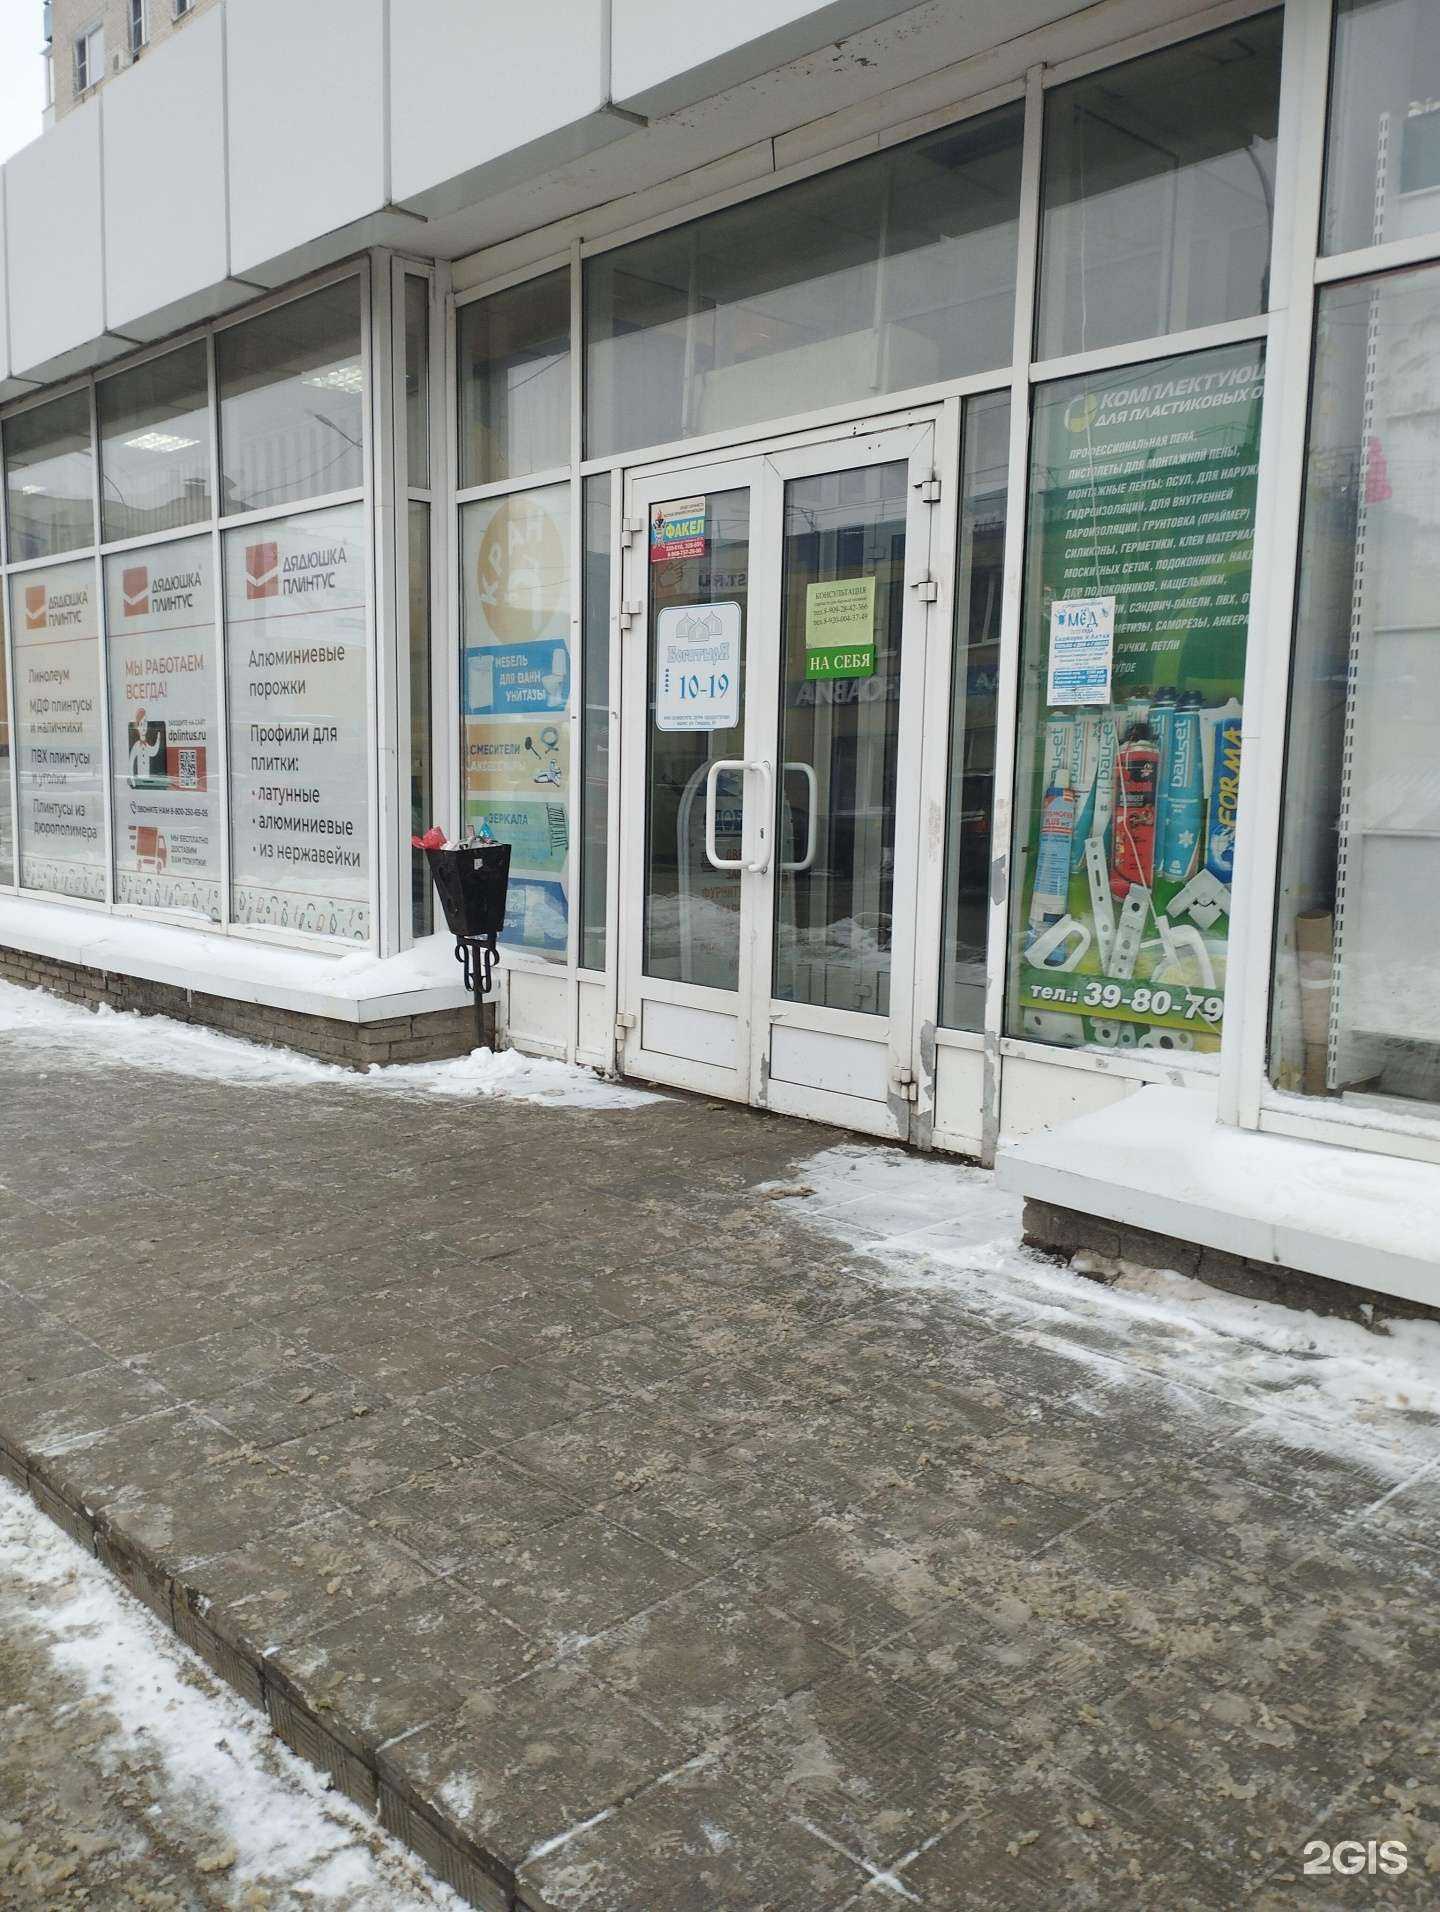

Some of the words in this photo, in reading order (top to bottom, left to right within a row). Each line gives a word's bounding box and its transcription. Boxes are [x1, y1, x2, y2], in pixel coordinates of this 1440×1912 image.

[1095, 411, 1128, 427] ДЛЯ
[1129, 386, 1250, 421] ПЛАСТИКОВЫХ
[1069, 436, 1169, 460] ПРОФЕССИОНАЛЬНАЯ
[1068, 462, 1123, 480] ПИСТОЛЕТЫ
[1124, 459, 1146, 475] ДЛЯ
[1147, 450, 1208, 470] МОНТАЖНОЙ
[1067, 482, 1127, 500] МОНТАЖНЫЕ
[1197, 469, 1219, 484] ДЛЯ
[1220, 464, 1259, 480] НАРУЖ
[1149, 497, 1171, 512] ДЛЯ
[1172, 488, 1234, 508] ВНУТРЕННЕЙ
[665, 519, 705, 539] ФАКЕЛ
[1142, 515, 1196, 532] ГРУНТОВКА
[1198, 508, 1250, 527] (ПРАЙМЕР)
[283, 547, 347, 573] ДЯДЮШКА
[1063, 564, 1120, 579] МОСКИТНЫХ
[152, 572, 202, 594] ДЯДЮШКА
[283, 571, 336, 595] ПЛИНТУС
[815, 587, 867, 600] КОНСУЛЬТАЦИЯ
[49, 590, 88, 610] ДЯДЮШКА
[152, 593, 193, 613] ПЛИНТУС
[49, 610, 82, 628] ПЛИНТУС
[1067, 607, 1099, 628] МЁД
[1150, 639, 1181, 653] ПЕТЛИ
[125, 659, 143, 677] МЫ
[146, 654, 204, 675] РАБОТАЕМ
[249, 646, 345, 668] Алюминиевые
[810, 656, 830, 671] НА
[833, 653, 870, 670] СЕБЯ
[28, 668, 70, 685] Линолеум
[680, 672, 729, 699] 10-19
[126, 680, 168, 701] ВСЕГДА!
[250, 679, 306, 700] порожки
[506, 686, 546, 703] УНИТАЗЫ
[30, 699, 49, 714] МДФ
[51, 699, 92, 715] плинтусы
[37, 722, 83, 735] наличники
[168, 730, 207, 745] dplintus.ru
[250, 724, 309, 746] Профили
[312, 726, 338, 744] для
[31, 748, 48, 764] ПВХ
[50, 752, 90, 768] плинтусы
[470, 744, 520, 756] СМЕСИТЕЛИ
[1171, 719, 1189, 788] bauset
[251, 756, 299, 772] плитки:
[258, 786, 320, 806] латунные
[33, 799, 73, 818] Плинтусы
[75, 804, 86, 816] из
[488, 812, 528, 826] ЗЕРКАЛА
[258, 814, 353, 836] алюминиевые
[258, 843, 274, 858] из
[277, 845, 360, 867] нержавейки
[1083, 982, 1224, 1022] 39-80-79
